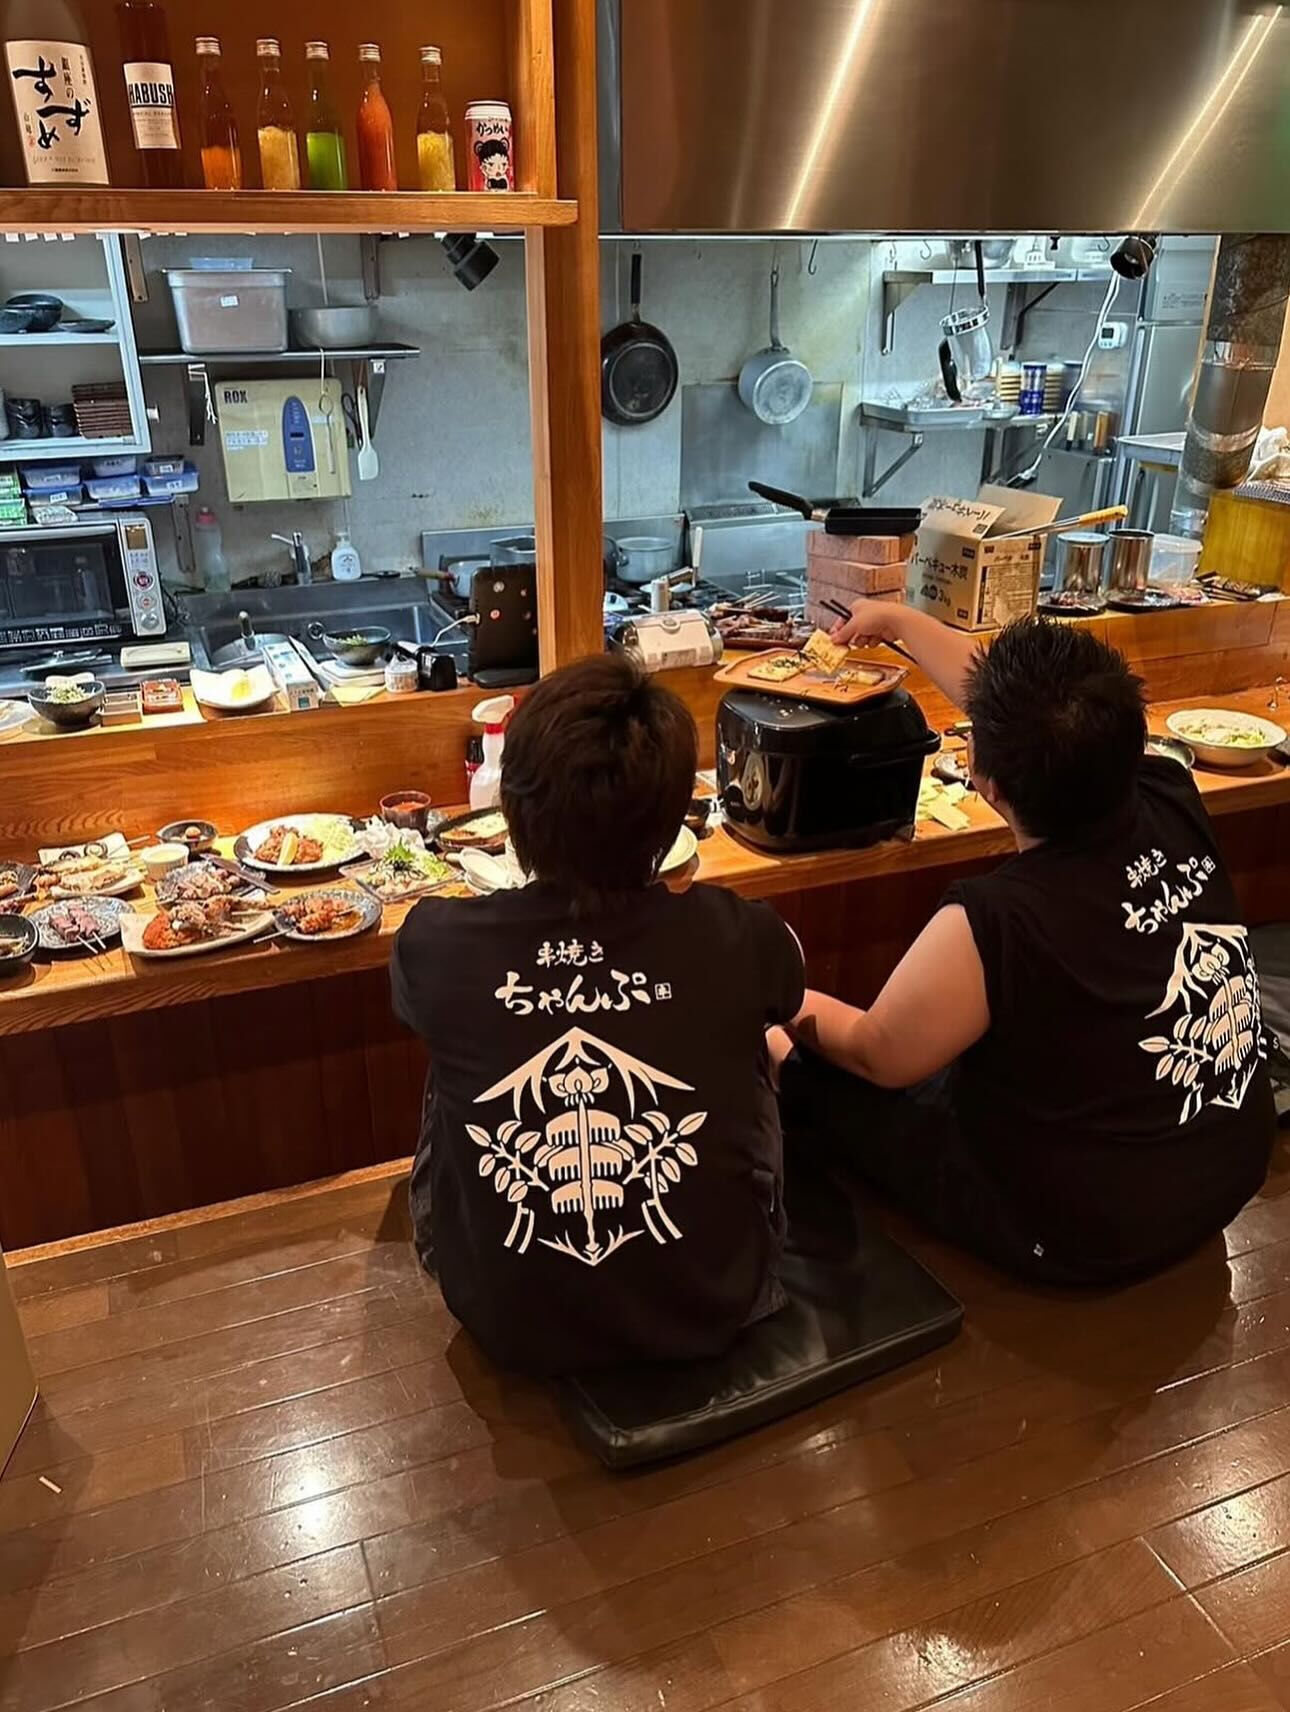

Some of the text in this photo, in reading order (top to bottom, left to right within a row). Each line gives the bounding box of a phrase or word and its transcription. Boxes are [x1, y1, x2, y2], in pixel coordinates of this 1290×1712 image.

[12, 55, 91, 149] すずめ
[223, 389, 248, 404] ROX
[535, 938, 605, 968] 串焼き
